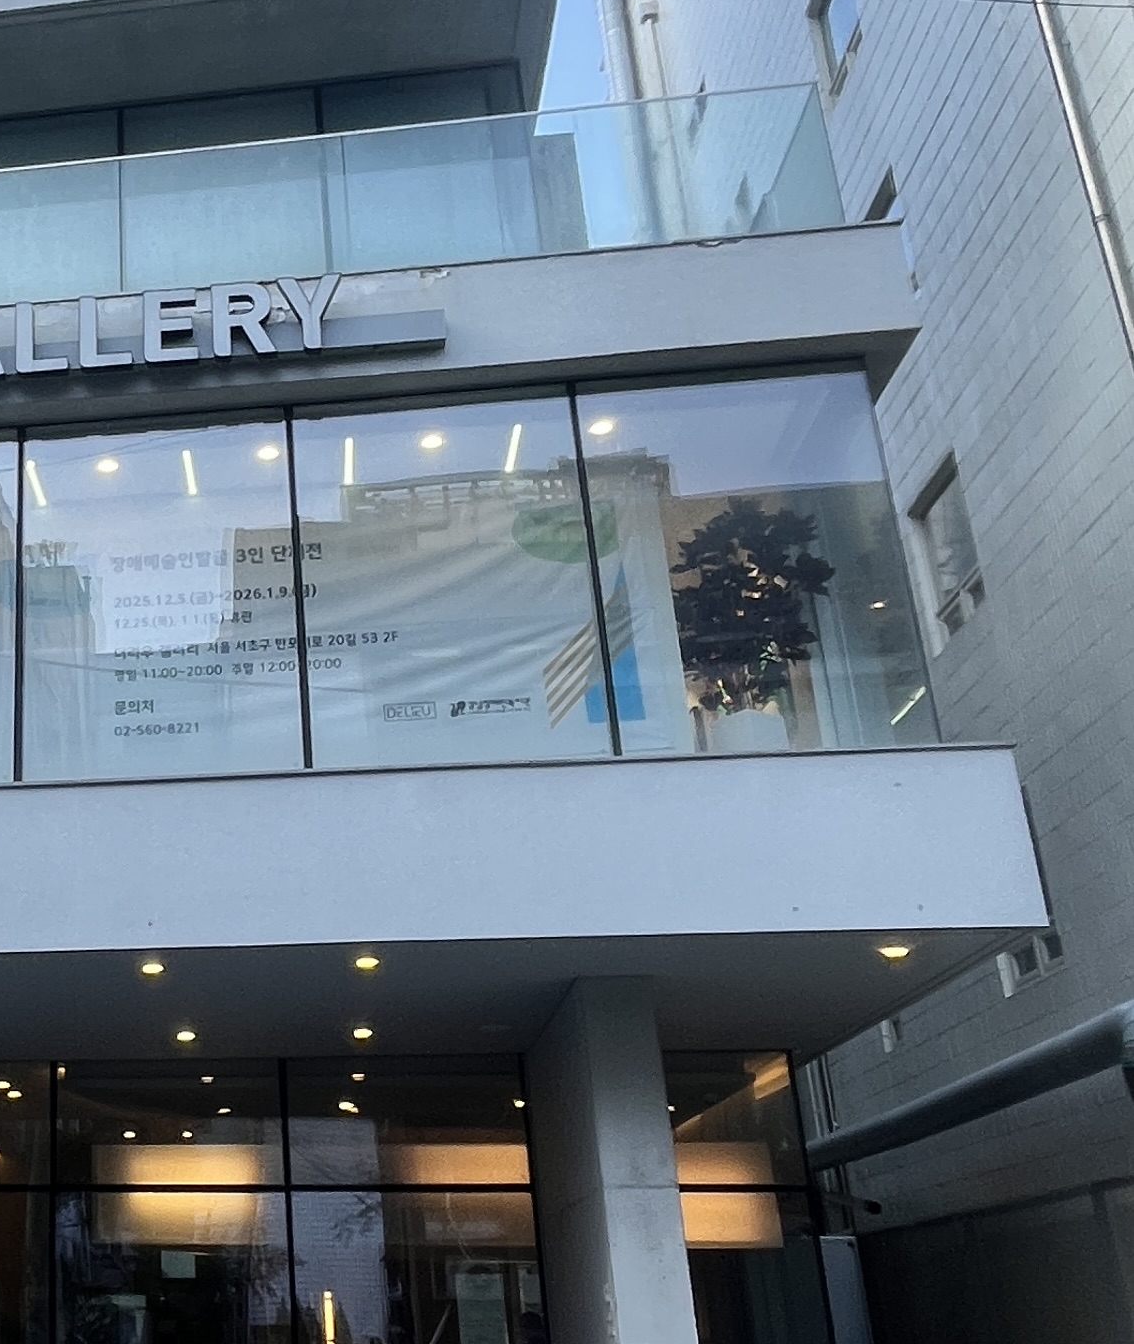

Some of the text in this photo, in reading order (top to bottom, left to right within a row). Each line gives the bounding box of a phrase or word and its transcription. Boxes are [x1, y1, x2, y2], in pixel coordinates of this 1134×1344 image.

[235, 547, 265, 564] 3인
[271, 542, 322, 563] 단전
[113, 722, 200, 737] 02-560-8221
